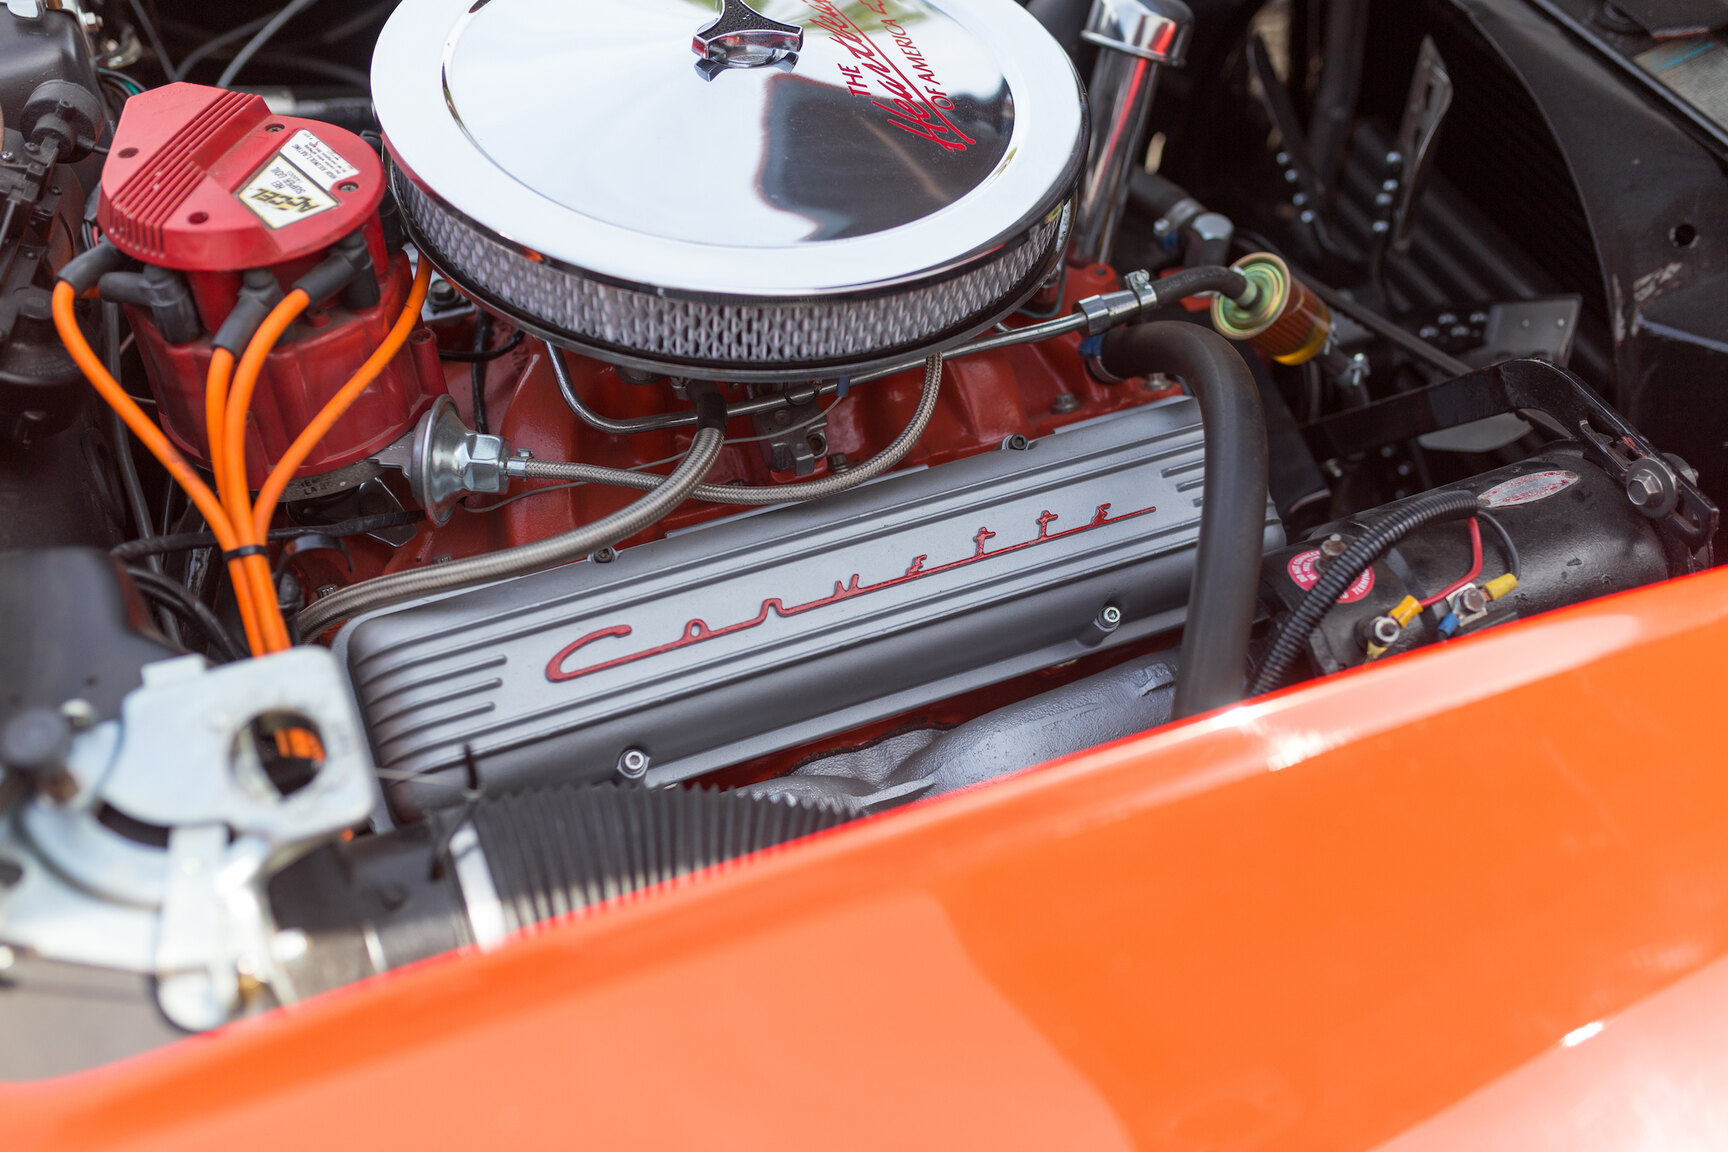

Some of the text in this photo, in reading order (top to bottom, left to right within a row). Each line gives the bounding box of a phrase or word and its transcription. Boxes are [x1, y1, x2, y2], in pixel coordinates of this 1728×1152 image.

[802, 0, 977, 152] Heartbea
[837, 63, 872, 97] THE
[880, 19, 955, 110] OF AMERICA
[251, 188, 320, 213] ACCEL
[283, 178, 306, 194] SUPER
[546, 503, 1156, 681] Corvette
[1351, 568, 1370, 596] TERMIN
